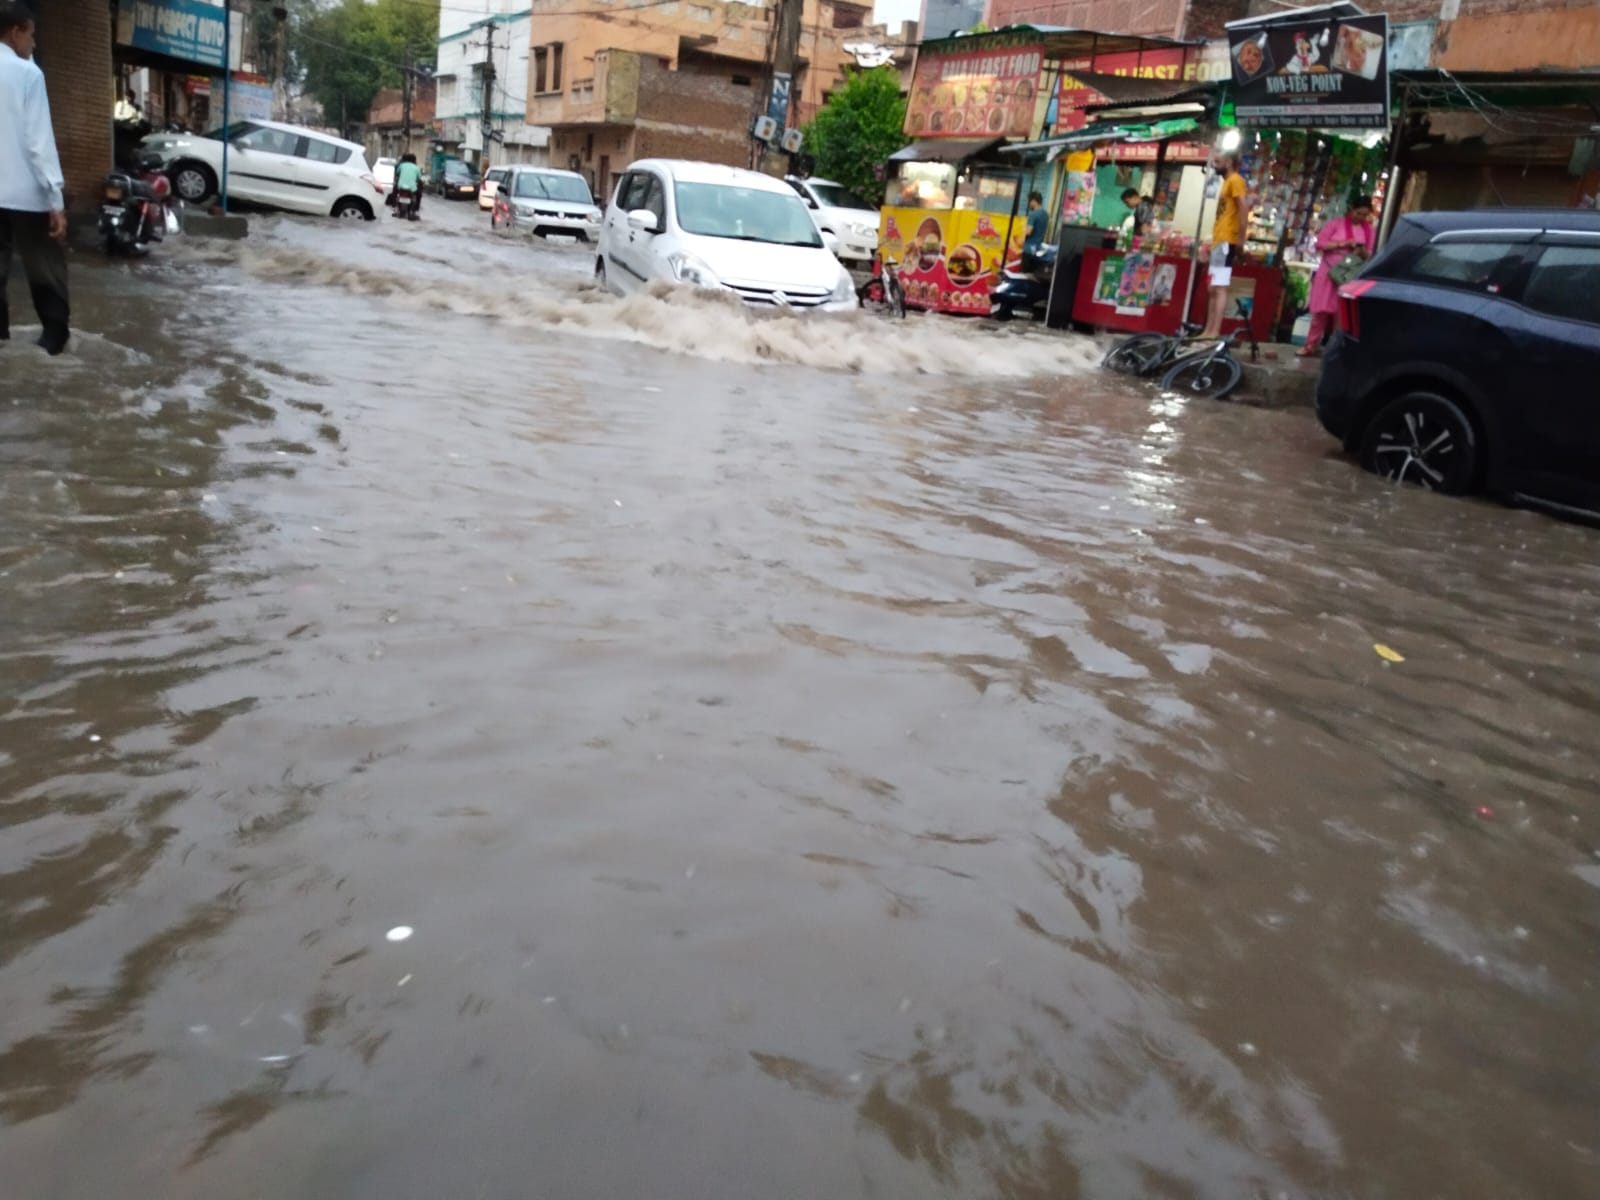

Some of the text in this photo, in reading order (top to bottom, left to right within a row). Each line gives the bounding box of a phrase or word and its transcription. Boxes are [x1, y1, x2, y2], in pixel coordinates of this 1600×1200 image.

[980, 56, 1008, 78] FAST
[1008, 52, 1041, 76] FOOD
[1132, 64, 1178, 80] FAST
[1266, 73, 1343, 93] NON-VEG POINT
